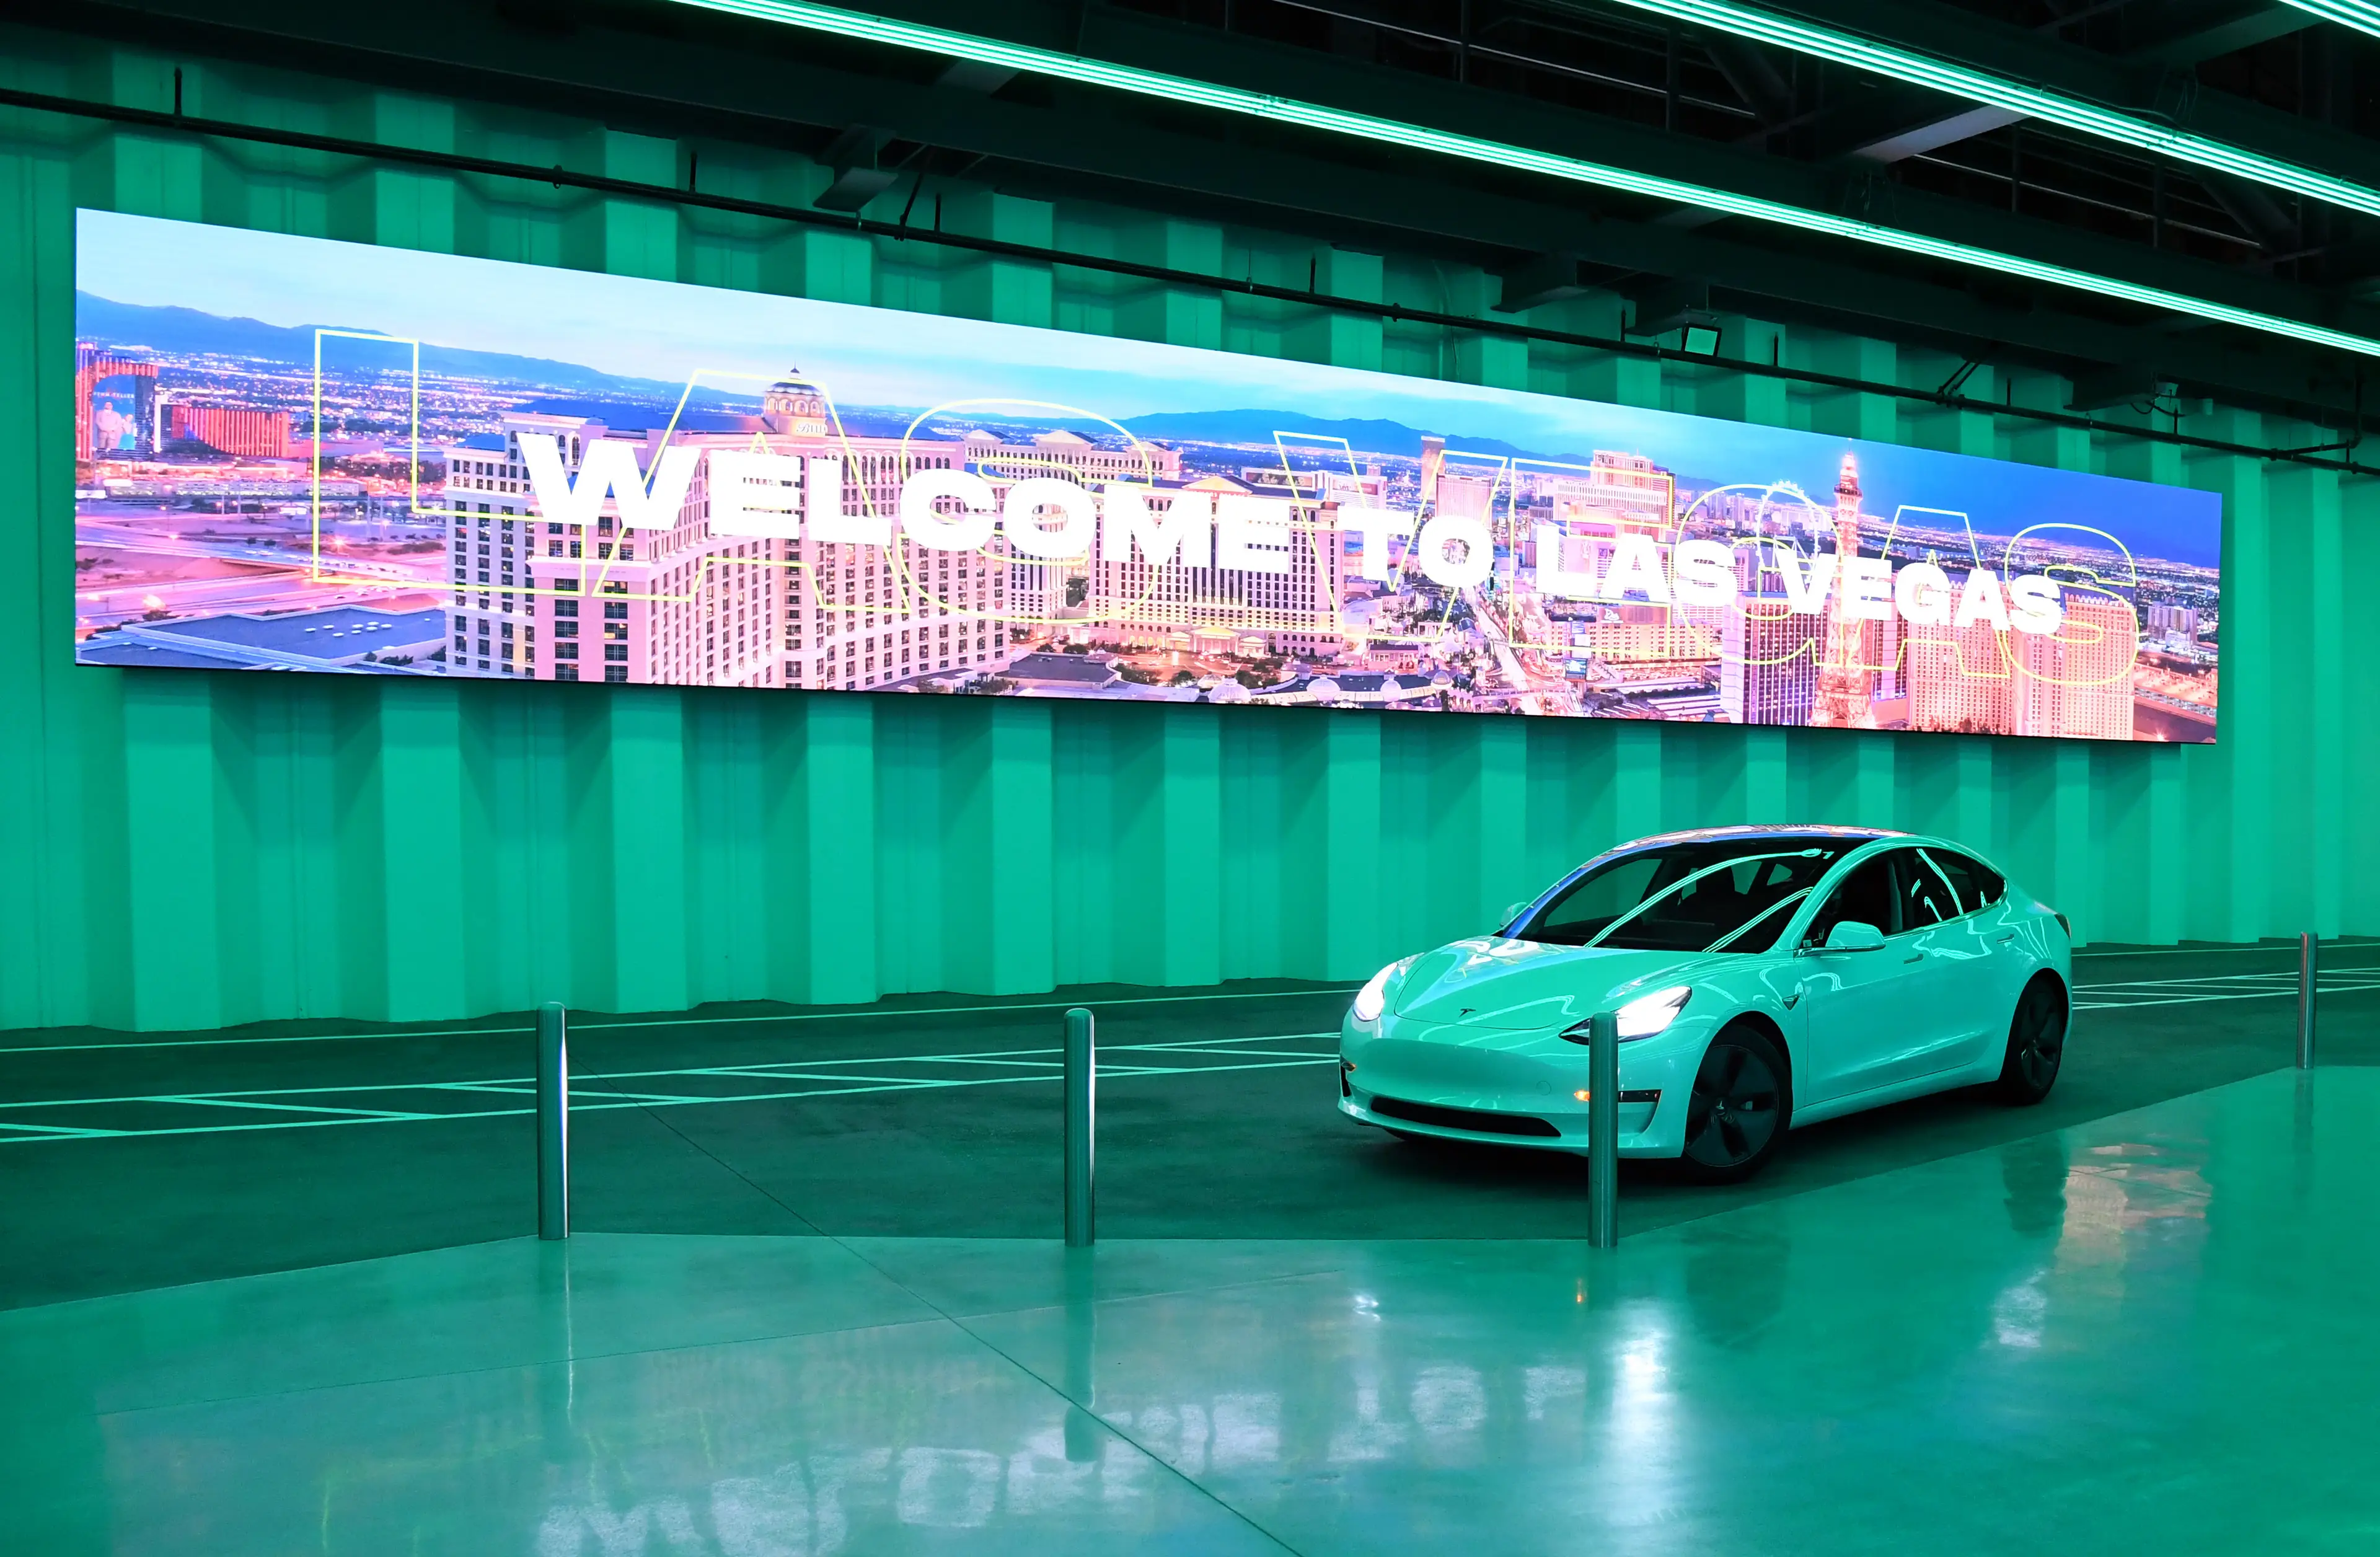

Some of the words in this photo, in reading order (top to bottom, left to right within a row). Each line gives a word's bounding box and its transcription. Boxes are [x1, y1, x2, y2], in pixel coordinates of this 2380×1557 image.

[314, 329, 1159, 624] LAS
[1272, 430, 2140, 686] VEGAS
[516, 432, 1290, 574] WELCOME
[1338, 505, 1494, 588] TO
[1536, 522, 1736, 607] LAS
[1774, 547, 2063, 635] VEGAS
